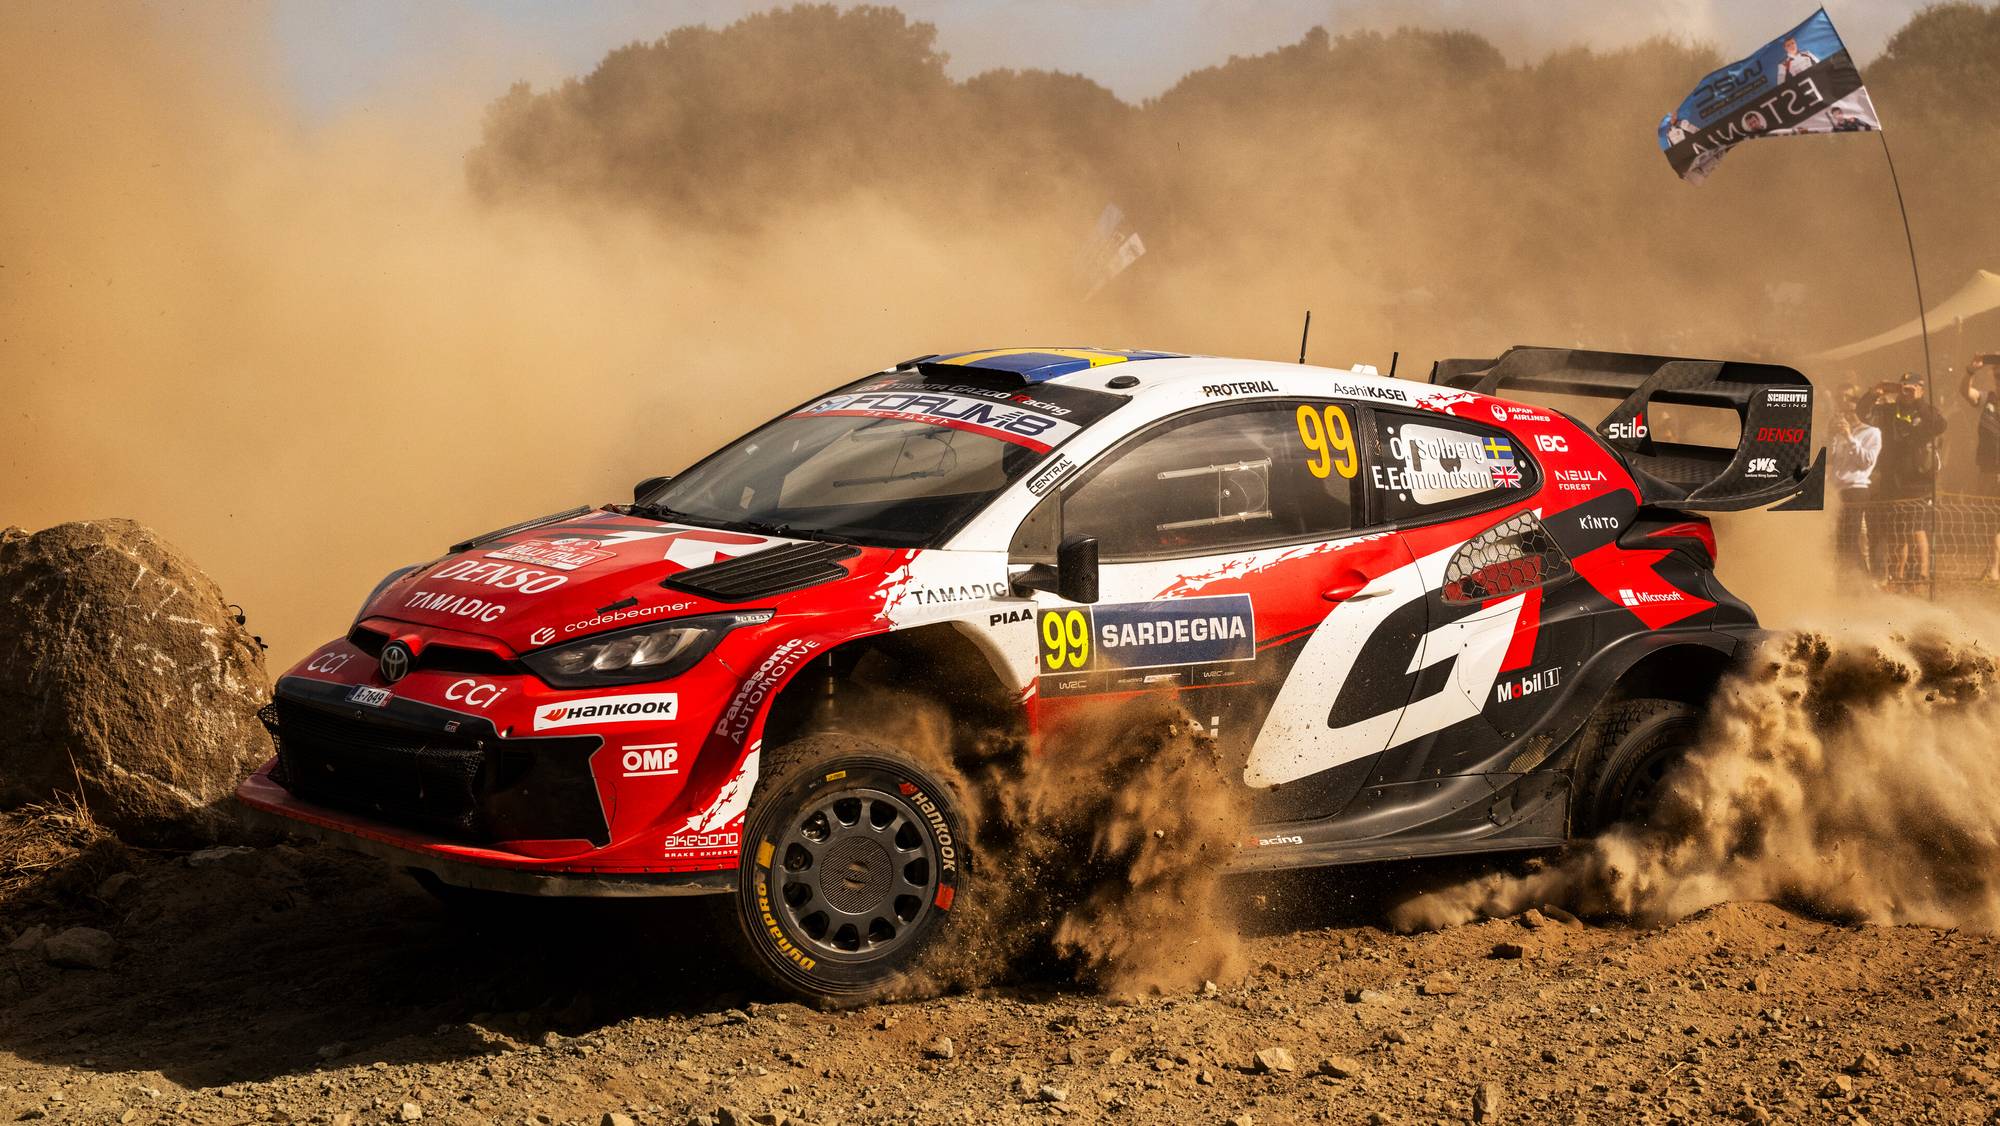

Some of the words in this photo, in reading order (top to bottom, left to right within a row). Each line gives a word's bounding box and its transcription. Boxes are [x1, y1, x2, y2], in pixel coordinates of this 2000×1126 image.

[951, 384, 1012, 400] GAZOO
[1010, 393, 1073, 416] Racing
[1202, 380, 1279, 398] PROTERIAL
[1333, 382, 1407, 401] AsahiKASEI
[1767, 393, 1808, 403] SCHROTH
[1507, 406, 1533, 415] JAPAN
[1513, 413, 1551, 423] AIRLINES
[1608, 413, 1648, 440] Stilo
[1756, 427, 1805, 443] DENSO
[1296, 404, 1358, 479] 99
[1413, 437, 1483, 464] Solberg
[1028, 456, 1073, 495] CENTRAL
[1748, 457, 1780, 474] SWS
[1558, 483, 1591, 491] FOREST
[430, 558, 569, 595] DENSO
[911, 581, 1008, 605] TAMADIC
[1636, 591, 1684, 603] Microsoft
[404, 591, 506, 623] TAMADIC
[564, 602, 694, 633] codebeamer
[989, 608, 1033, 626] PIAA
[1042, 610, 1089, 669] 99
[1101, 615, 1247, 648] SARDEGNA
[715, 638, 803, 737] Panasonic
[730, 640, 821, 745] AUTOMOTIVE
[1497, 673, 1542, 703] Mobil
[622, 747, 679, 772] OMP
[700, 849, 739, 857] EXPERTS
